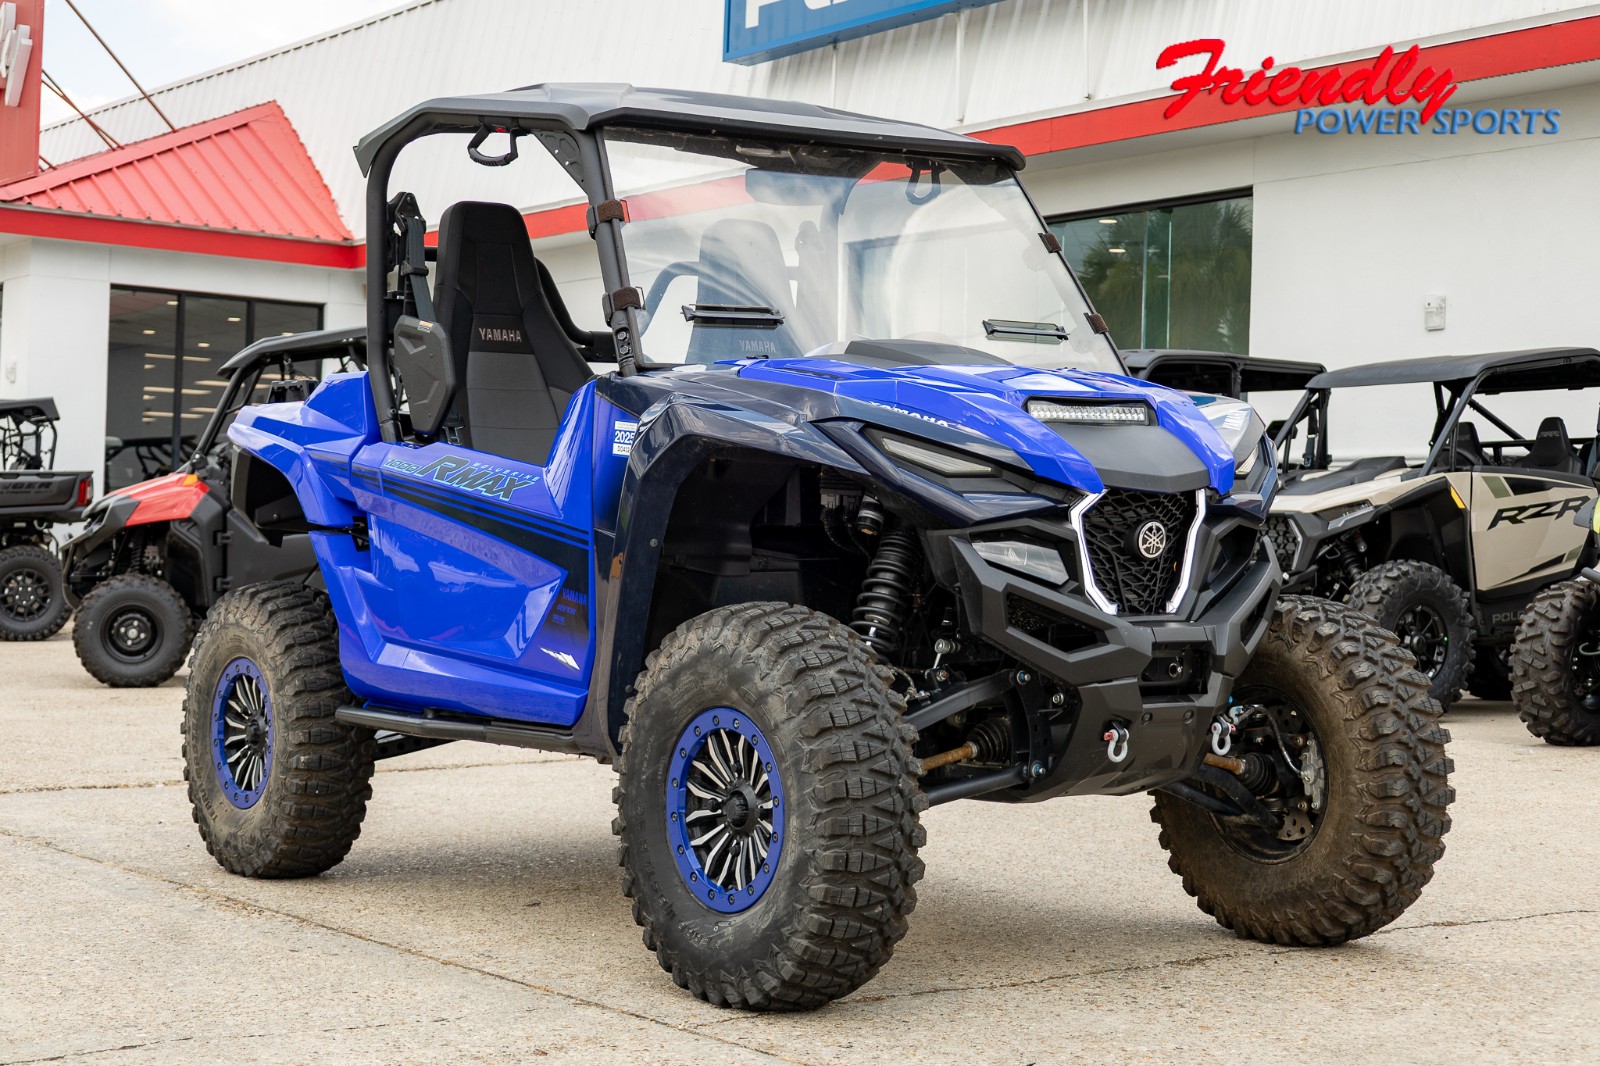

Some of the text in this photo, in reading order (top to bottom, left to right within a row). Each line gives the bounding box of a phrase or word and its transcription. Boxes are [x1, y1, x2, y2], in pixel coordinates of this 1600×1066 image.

[478, 327, 523, 343] YAMAHA
[738, 340, 776, 353] YAMAHA
[614, 430, 635, 444] 2025
[416, 455, 536, 501] RMAX
[1487, 496, 1591, 531] RZR
